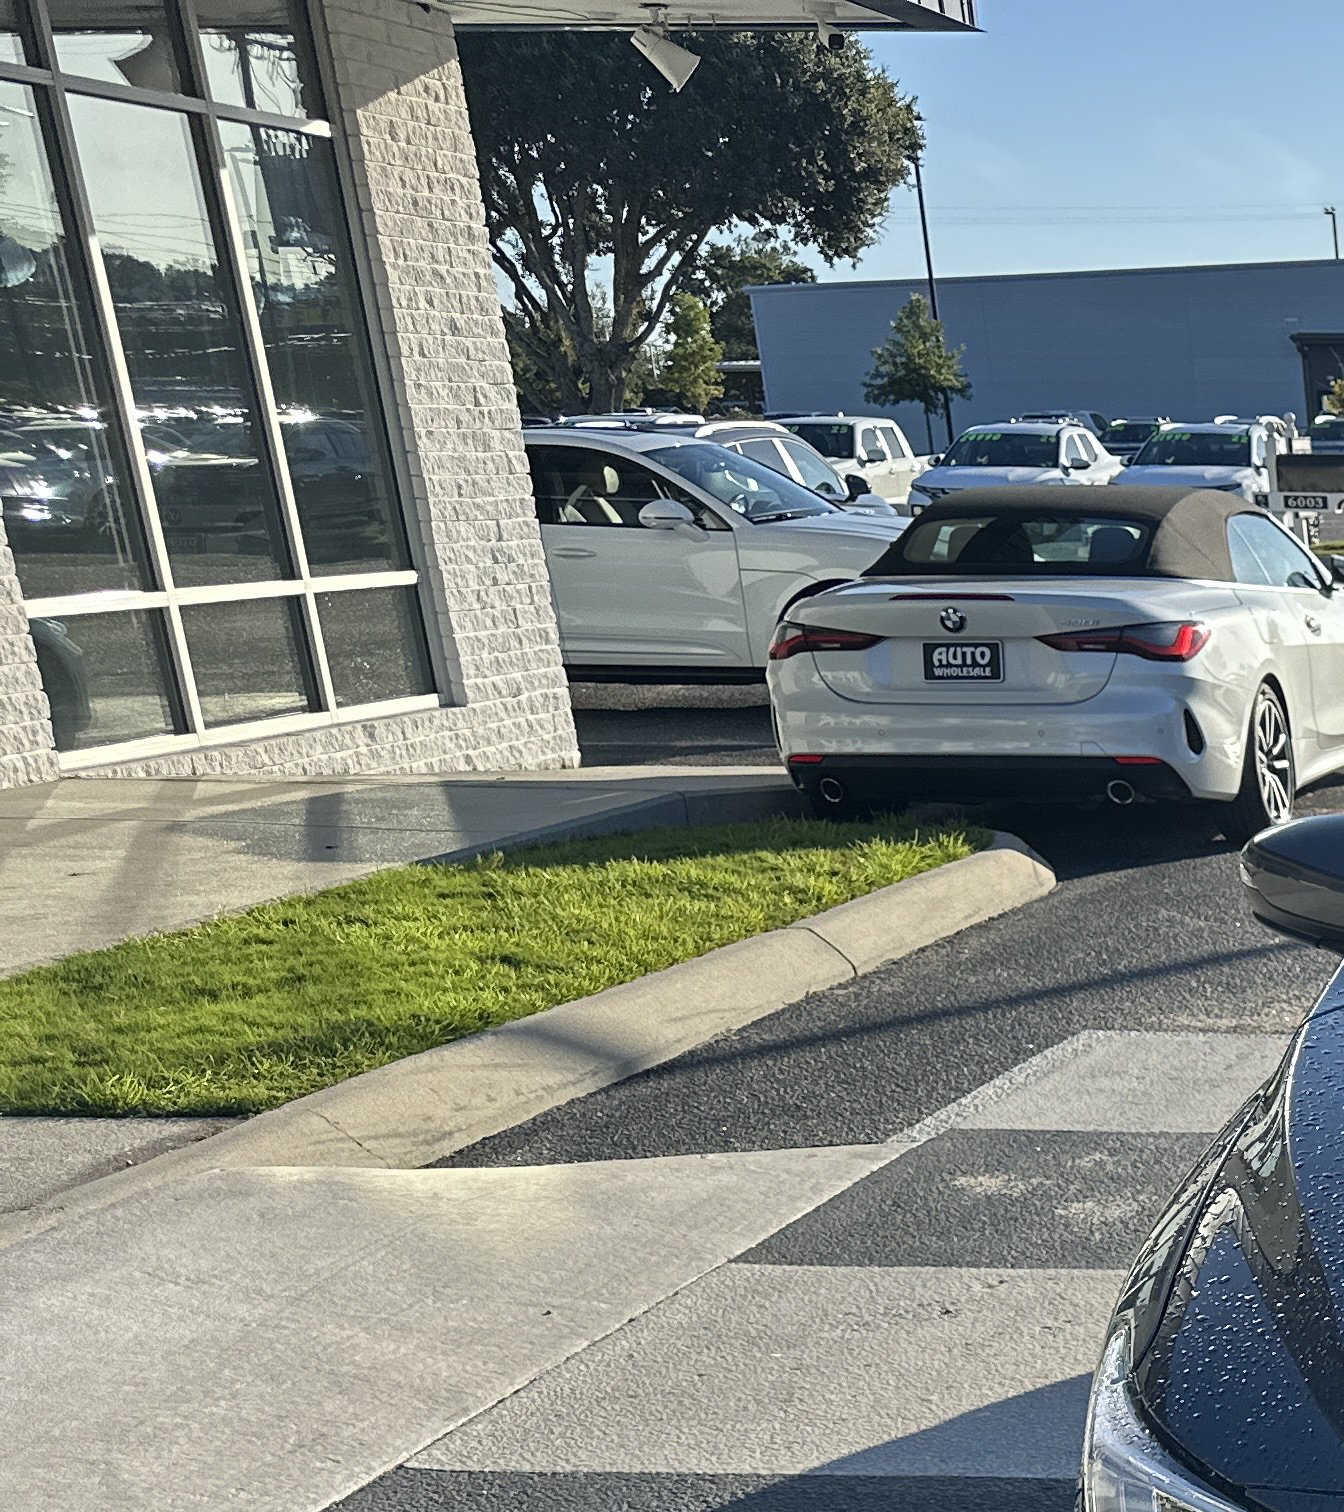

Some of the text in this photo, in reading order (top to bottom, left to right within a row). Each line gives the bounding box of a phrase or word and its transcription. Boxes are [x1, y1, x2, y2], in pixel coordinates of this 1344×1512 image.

[1287, 497, 1324, 508] 6003
[932, 646, 991, 668] AUTO
[933, 666, 993, 678] WHOLESALE
